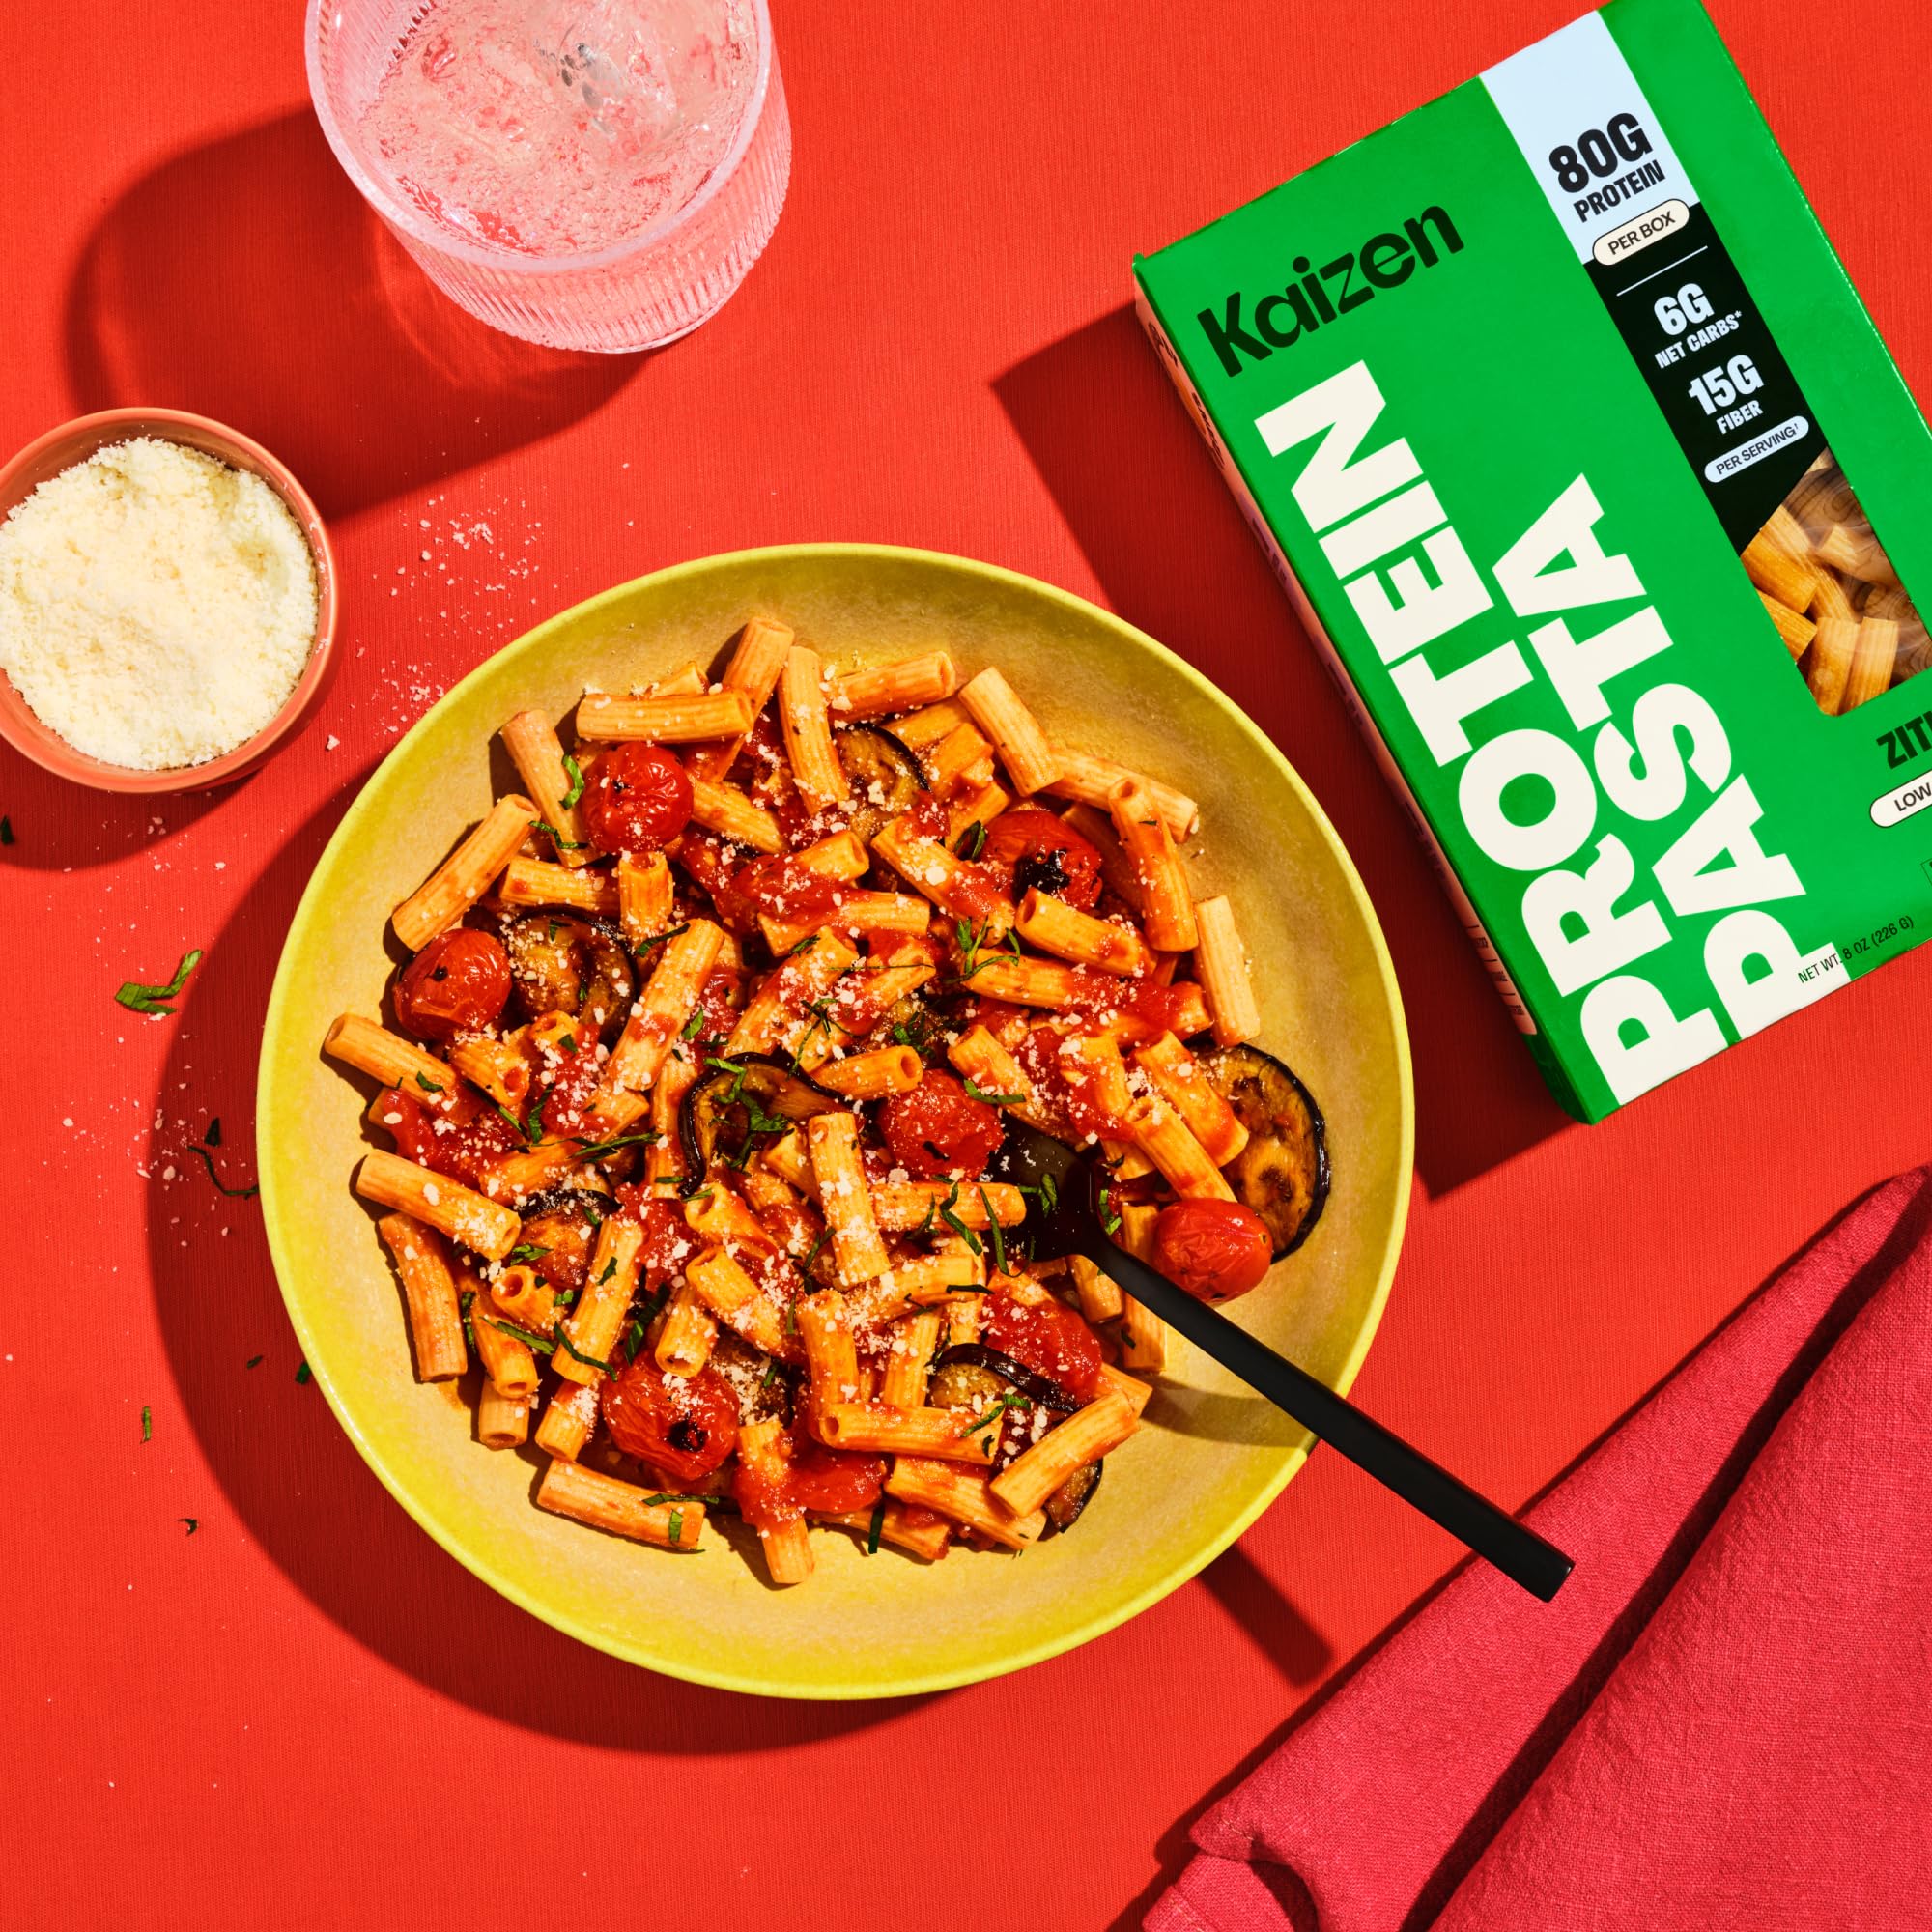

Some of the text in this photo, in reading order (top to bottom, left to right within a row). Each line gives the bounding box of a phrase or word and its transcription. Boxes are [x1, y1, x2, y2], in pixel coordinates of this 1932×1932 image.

[1548, 112, 1654, 193] 80G
[1573, 158, 1666, 223] PROTEIN
[1607, 211, 1676, 255] PER BOX
[1197, 205, 1465, 378] Kaizen
[1653, 282, 1715, 336] 6G
[1654, 341, 1687, 369] NET
[1688, 355, 1765, 416] 15G
[1716, 399, 1764, 435] FIBER
[1716, 455, 1743, 475] PER
[1254, 359, 1729, 1106] PROTEIN
[1492, 473, 1853, 1040] PASTA
[1894, 782, 1932, 812] LOW
[1798, 915, 1915, 983] NET WT. 8 OZ (226 G)
